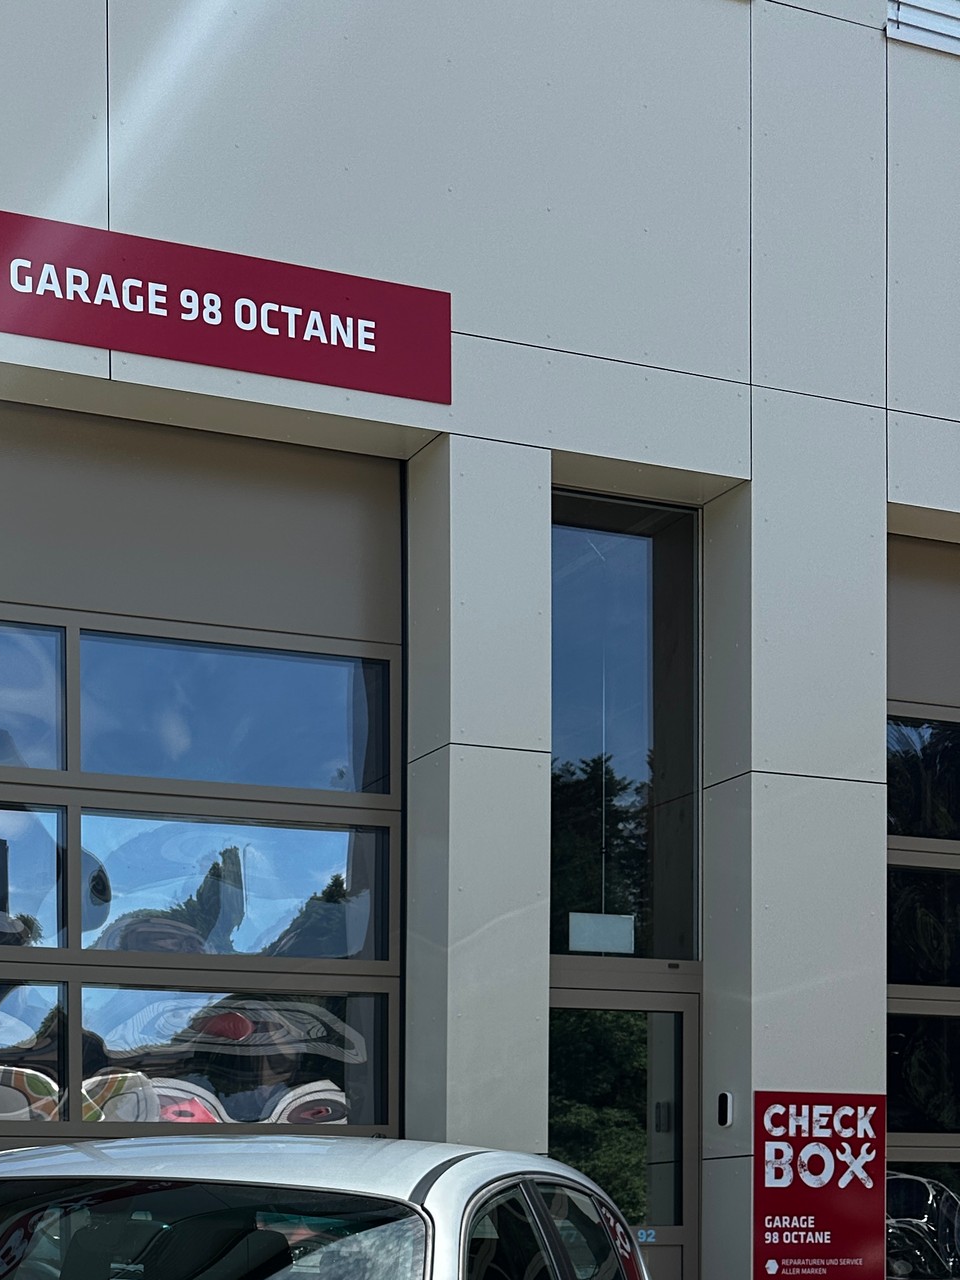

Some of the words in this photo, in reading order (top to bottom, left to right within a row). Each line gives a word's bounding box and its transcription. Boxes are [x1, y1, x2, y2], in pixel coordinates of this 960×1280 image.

[9, 258, 168, 317] GARAGE
[180, 288, 223, 325] 98
[234, 298, 376, 353] OCTANE
[763, 1104, 877, 1138] CHECK
[764, 1141, 876, 1189] BOX
[764, 1215, 815, 1228] GARAGE
[637, 1229, 656, 1242] 92
[764, 1231, 779, 1244] 98
[783, 1231, 831, 1244] OCTANE
[781, 1258, 825, 1266] REPARATUREN
[826, 1258, 839, 1266] UND
[839, 1258, 863, 1266] SERVICE
[781, 1267, 800, 1275] ALLER
[801, 1267, 827, 1275] MARKEN
